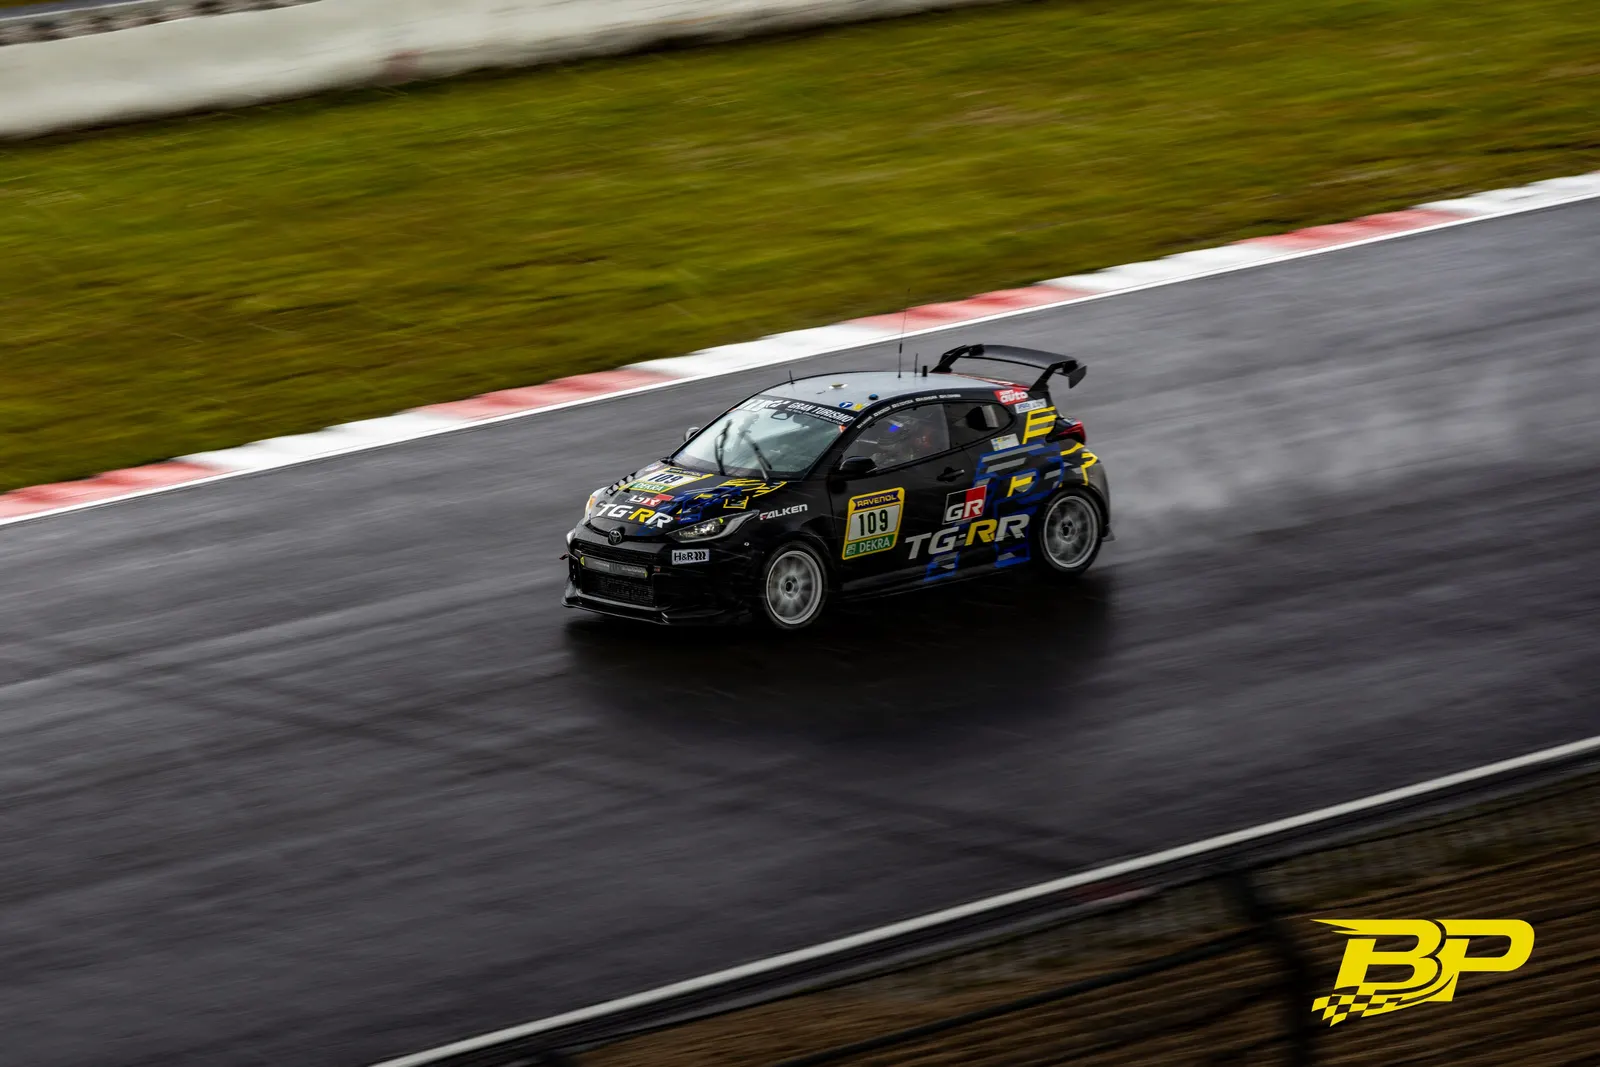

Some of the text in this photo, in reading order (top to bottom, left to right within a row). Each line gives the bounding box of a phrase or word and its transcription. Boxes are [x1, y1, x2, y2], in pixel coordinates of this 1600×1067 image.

[1000, 391, 1028, 403] auto
[788, 401, 816, 412] GRAN
[812, 406, 855, 423] TURISMO
[648, 473, 683, 484] 109
[856, 494, 896, 507] RAVENOL
[596, 502, 673, 528] TG-RR
[759, 503, 808, 521] FALKEN
[945, 499, 984, 522] GR
[858, 509, 889, 536] 109
[859, 536, 890, 553] DEKRA
[905, 513, 1030, 560] TG-RR
[674, 551, 694, 561] H&R
